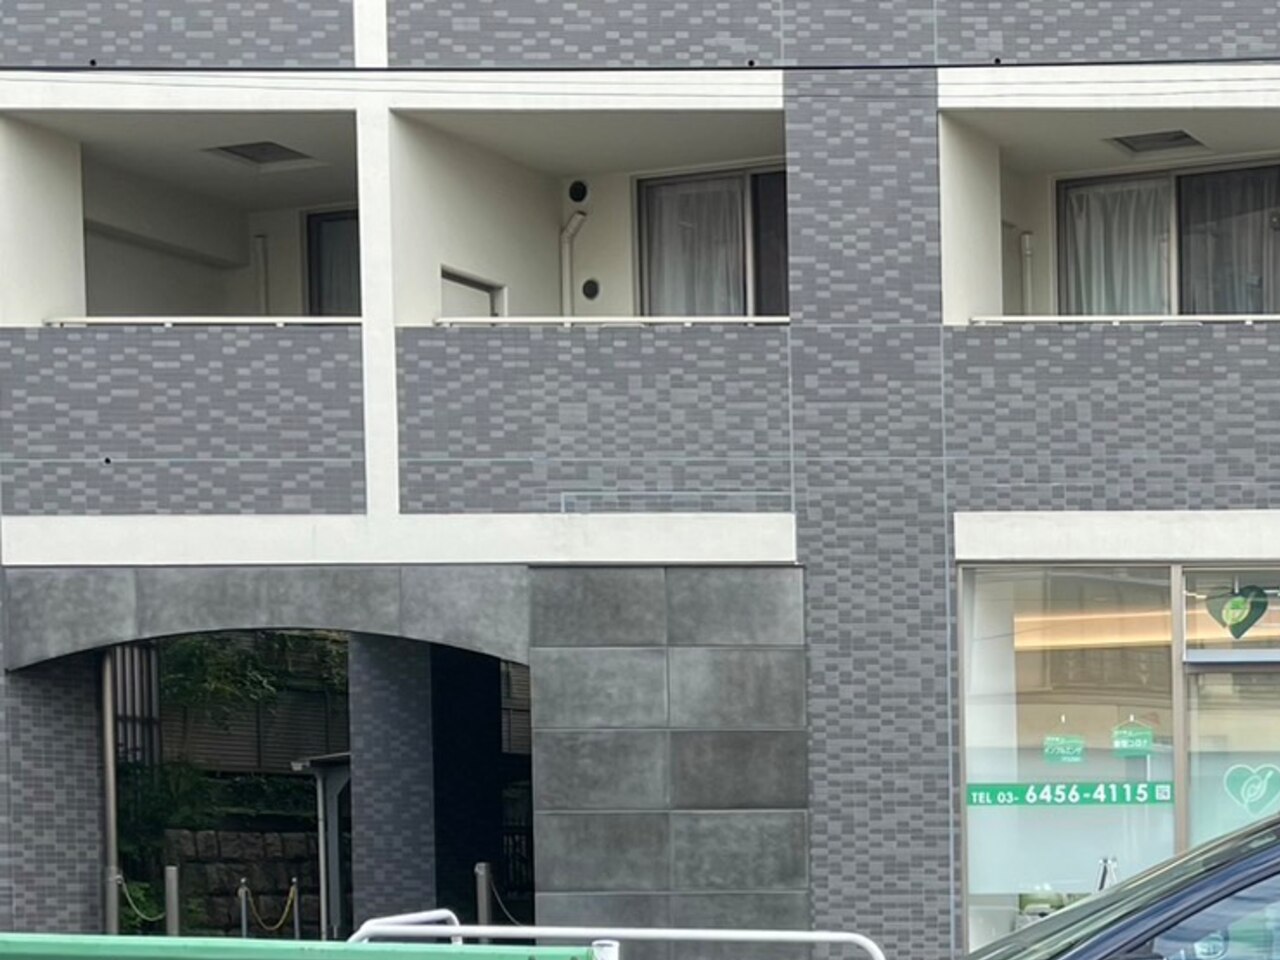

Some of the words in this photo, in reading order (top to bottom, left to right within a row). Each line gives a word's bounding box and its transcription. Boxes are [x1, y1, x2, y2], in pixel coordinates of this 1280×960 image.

[971, 792, 993, 804] TEL
[997, 791, 1020, 804] 03-
[1025, 783, 1149, 803] 6456-4115
